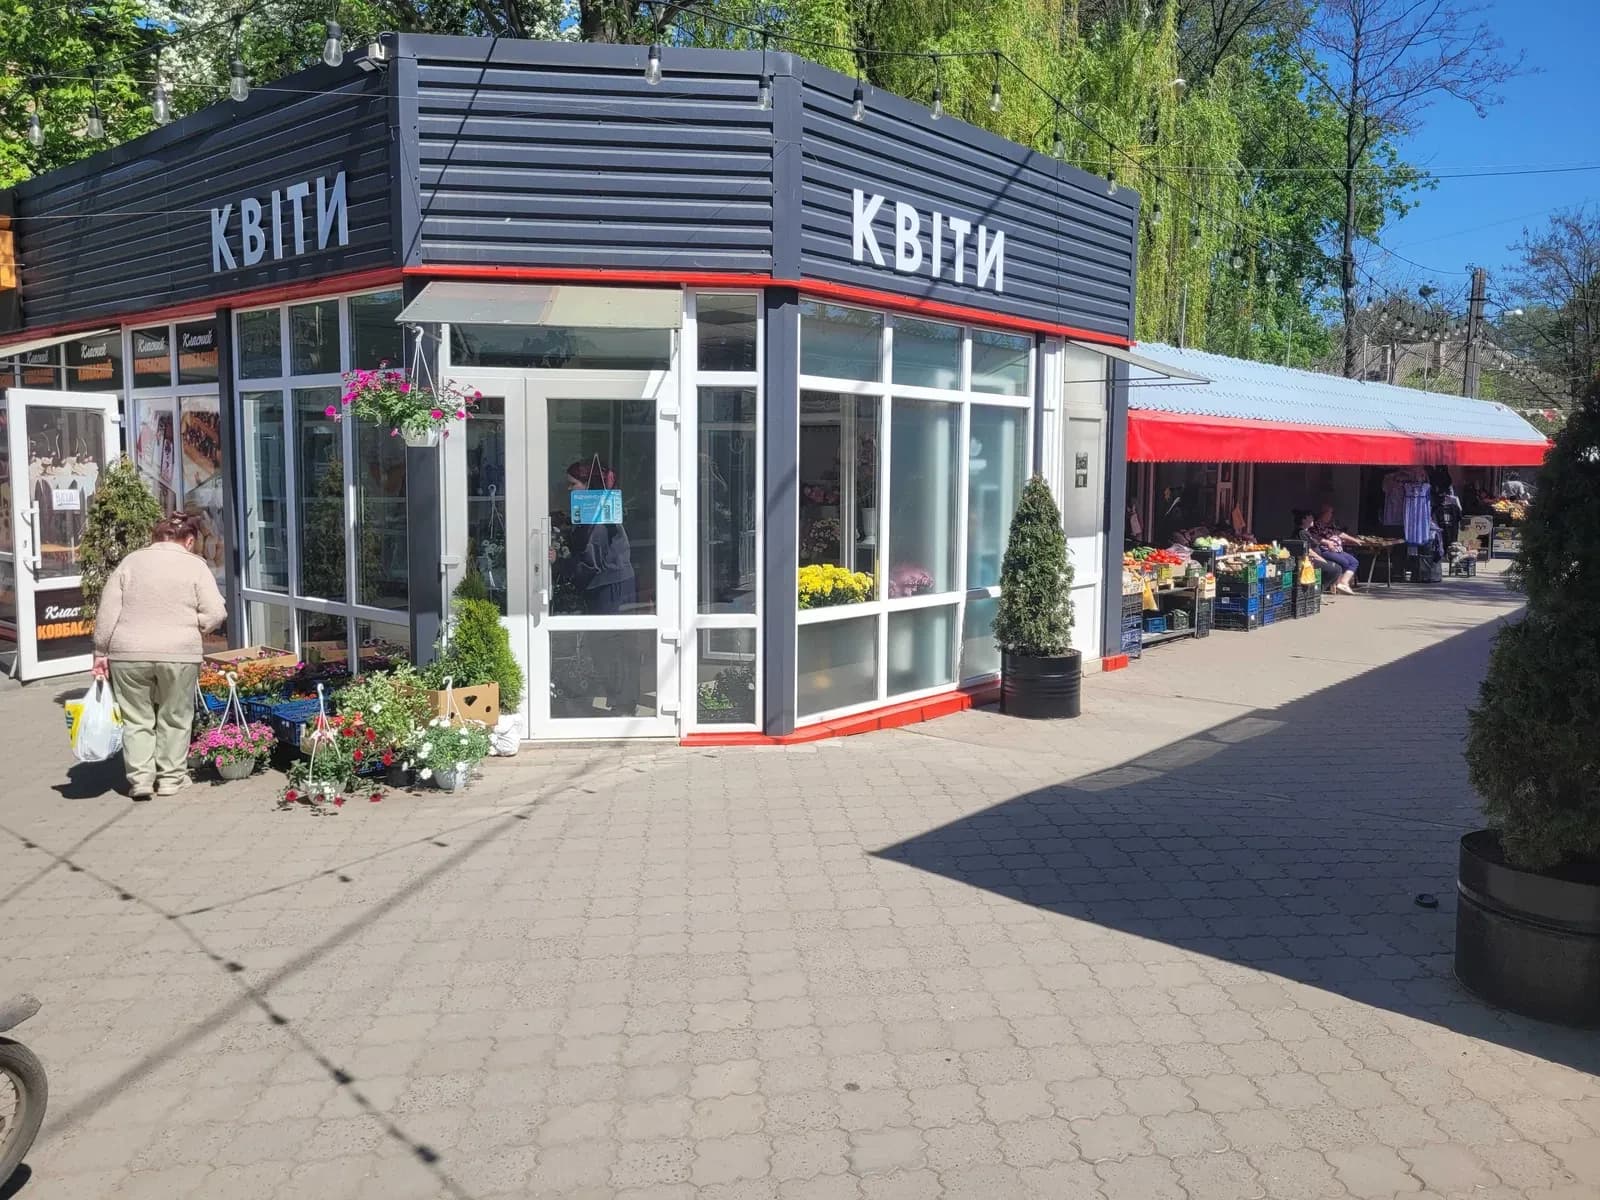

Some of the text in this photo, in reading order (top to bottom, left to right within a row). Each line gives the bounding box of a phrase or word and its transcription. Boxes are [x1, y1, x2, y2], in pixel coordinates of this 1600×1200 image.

[211, 170, 349, 273] КВІТИ
[852, 188, 1005, 292] КВІТИ
[36, 619, 96, 641] КОВБАС
[44, 605, 82, 620] Клас
